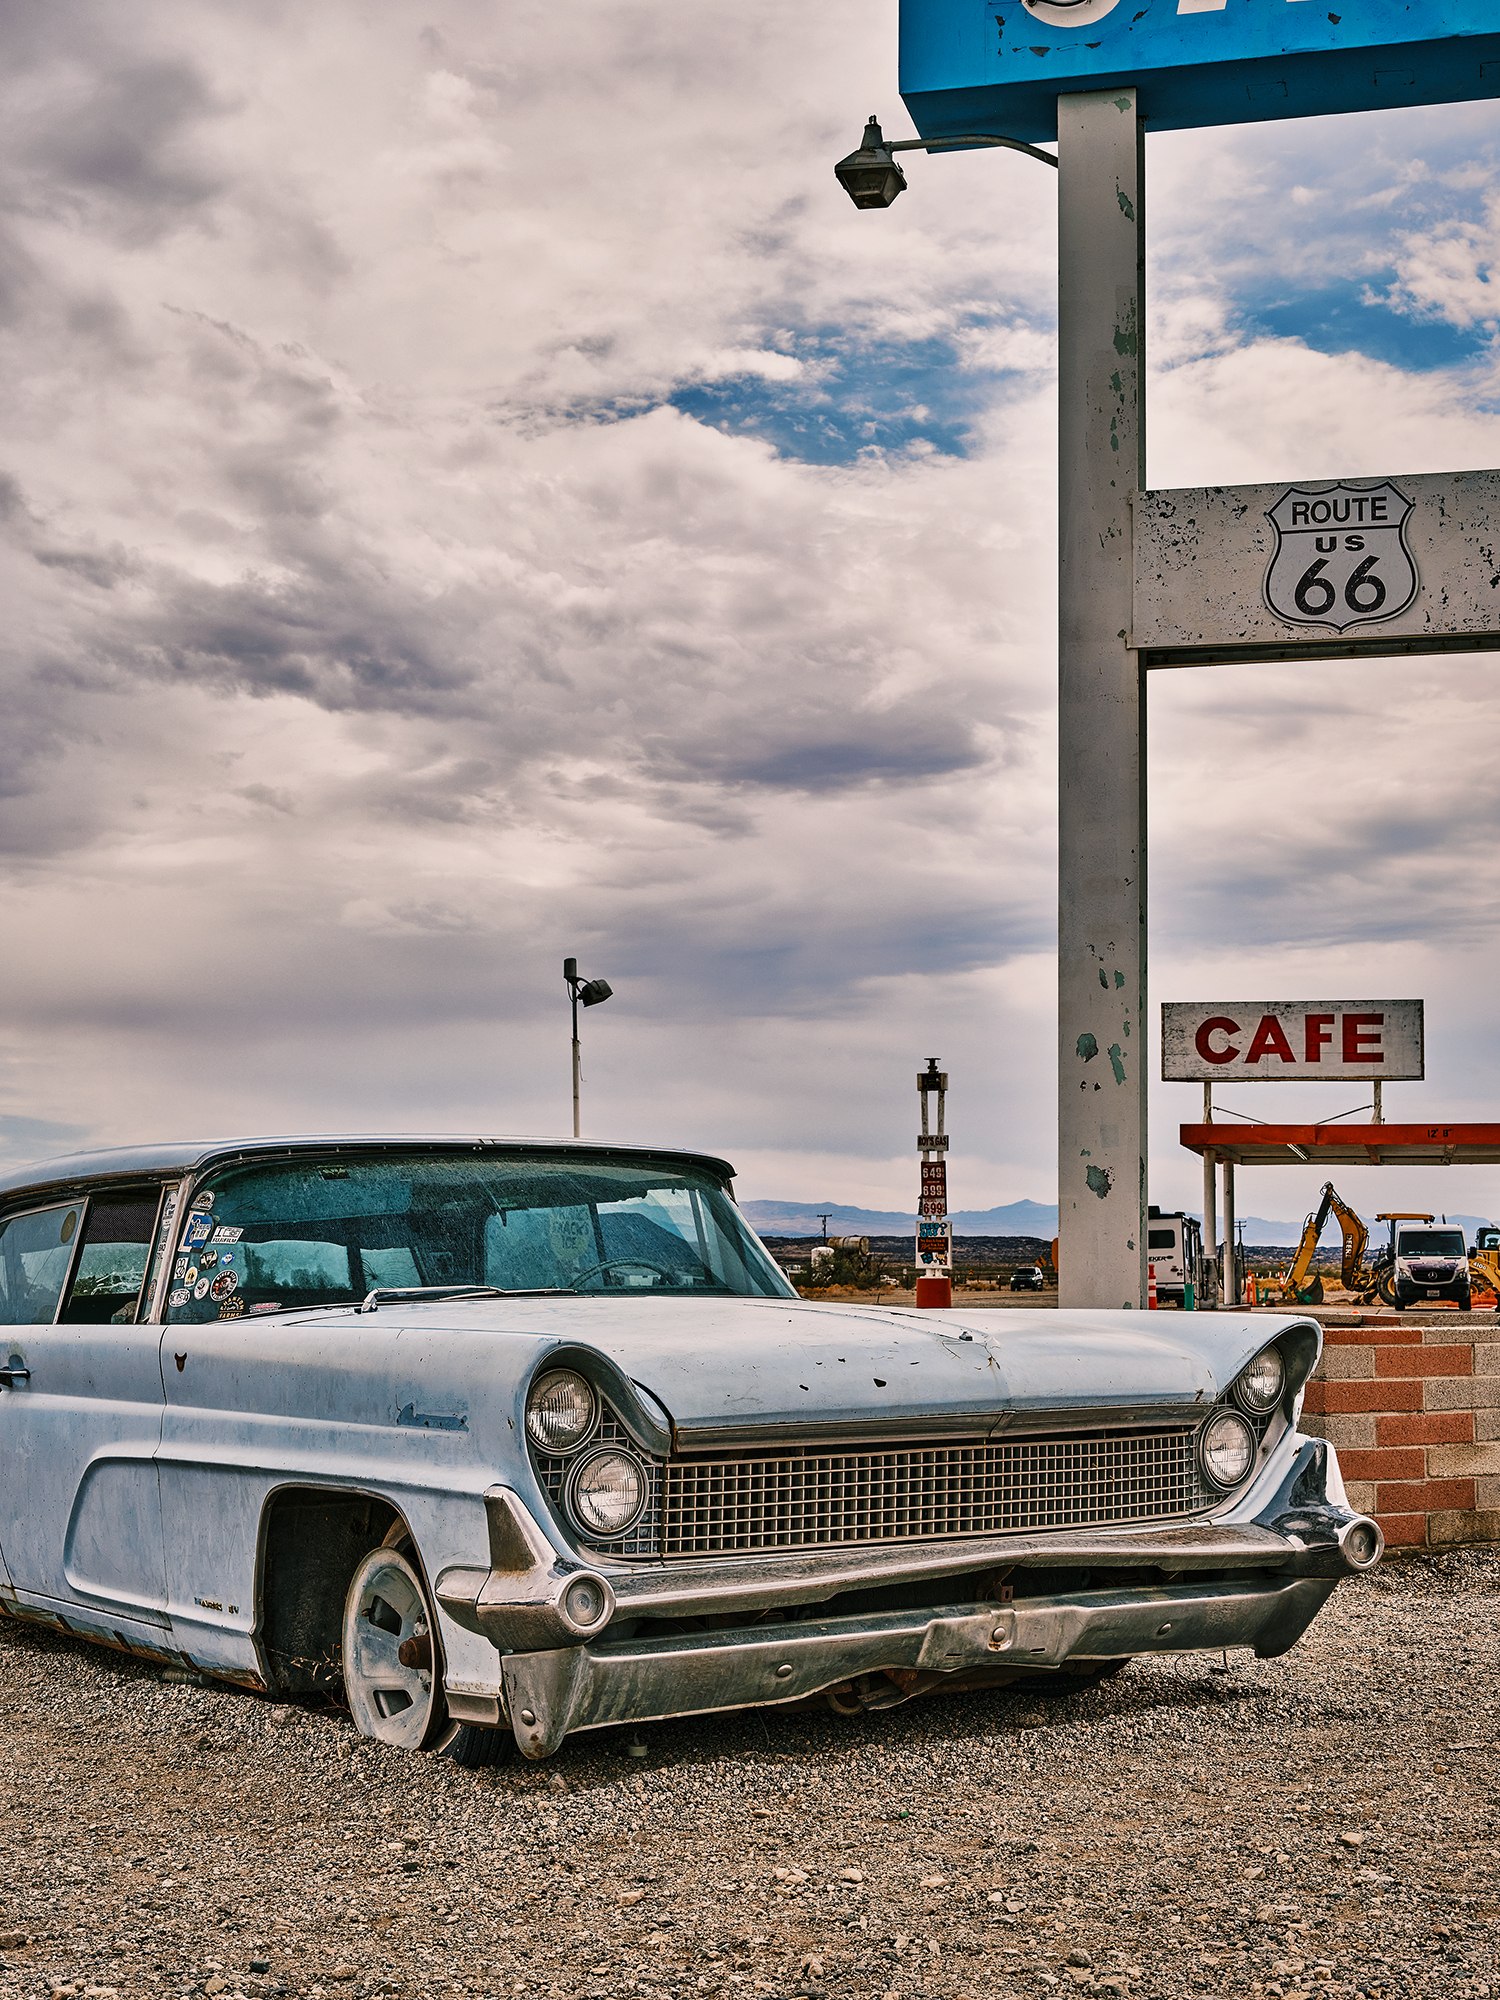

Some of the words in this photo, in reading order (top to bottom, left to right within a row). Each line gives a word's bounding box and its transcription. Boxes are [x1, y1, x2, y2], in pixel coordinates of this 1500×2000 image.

[1291, 496, 1388, 526] ROUTE
[1314, 534, 1366, 553] US
[1293, 555, 1387, 616] 66
[1194, 1013, 1385, 1065] CAFE
[918, 1137, 934, 1146] ROY'S
[935, 1137, 947, 1146] GAS
[1345, 1233, 1353, 1260] DEERE
